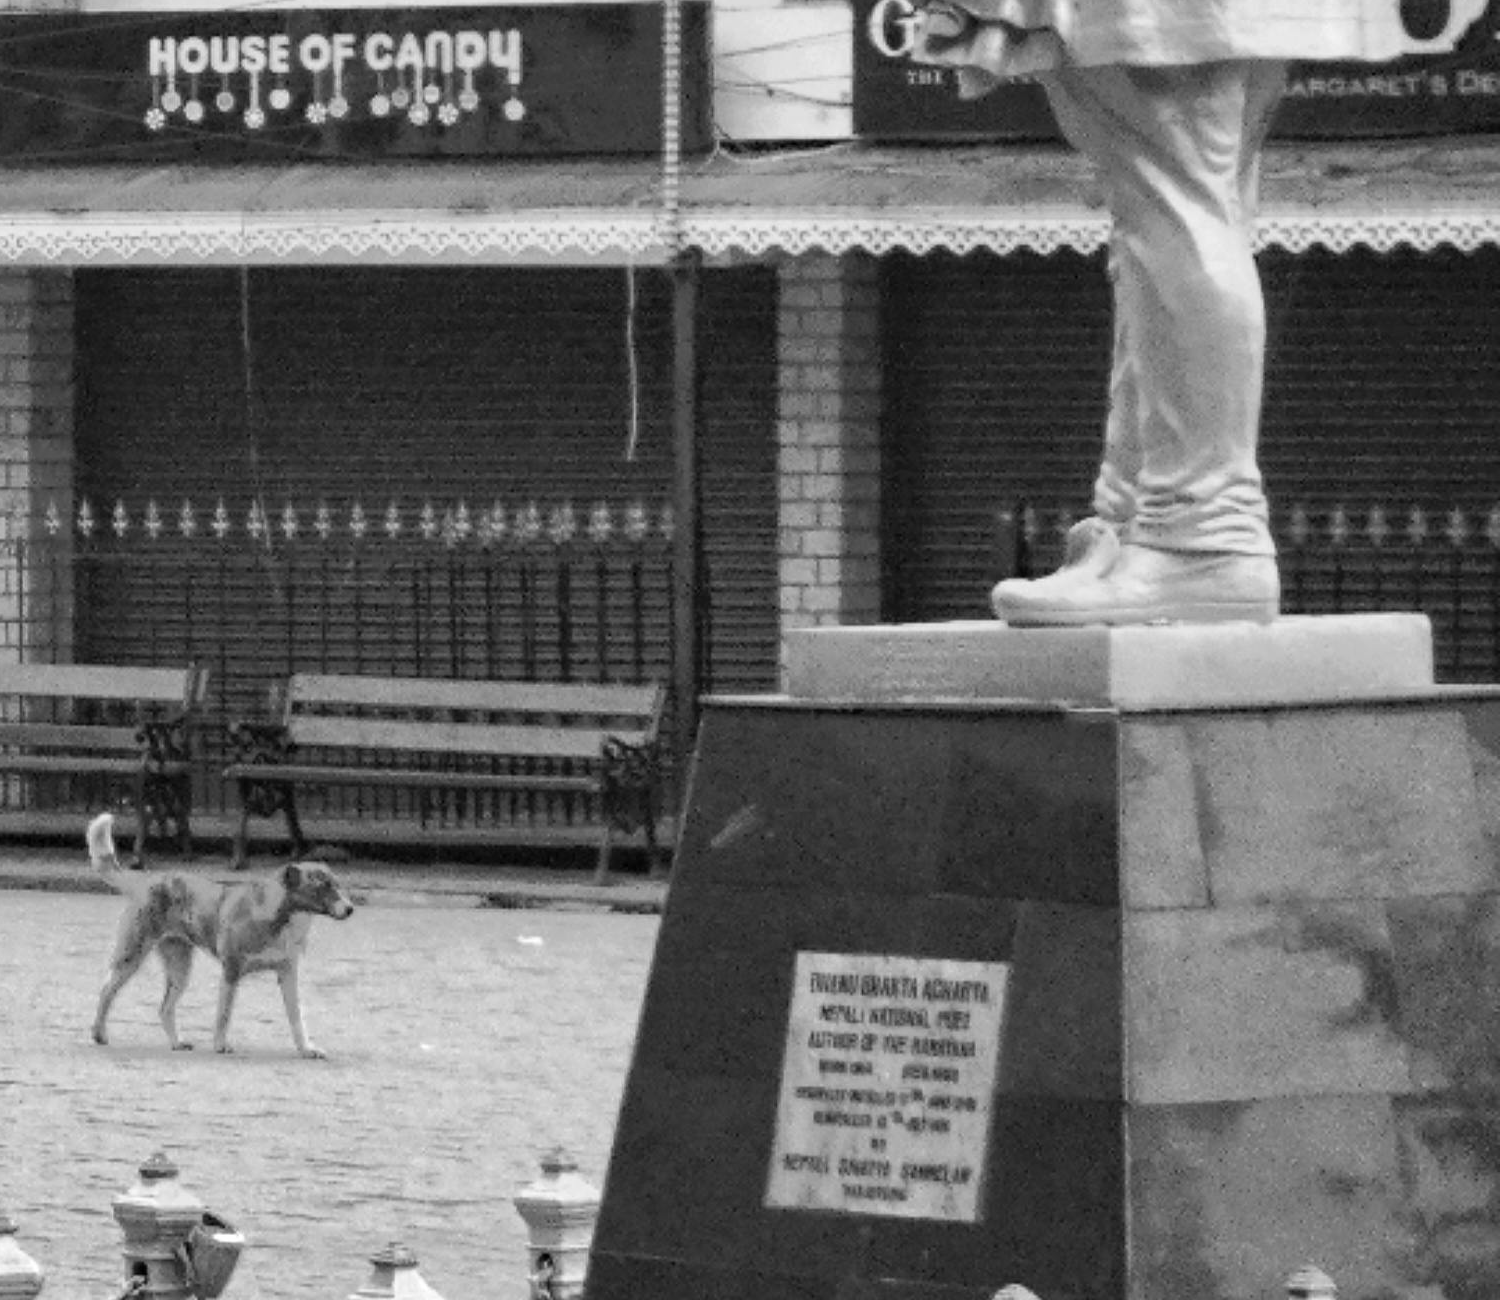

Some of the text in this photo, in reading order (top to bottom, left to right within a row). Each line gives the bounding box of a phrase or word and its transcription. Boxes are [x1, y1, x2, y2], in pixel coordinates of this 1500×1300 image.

[149, 28, 522, 85] HOUSE OF CANDY
[1285, 70, 1448, 98] ARGARET'S
